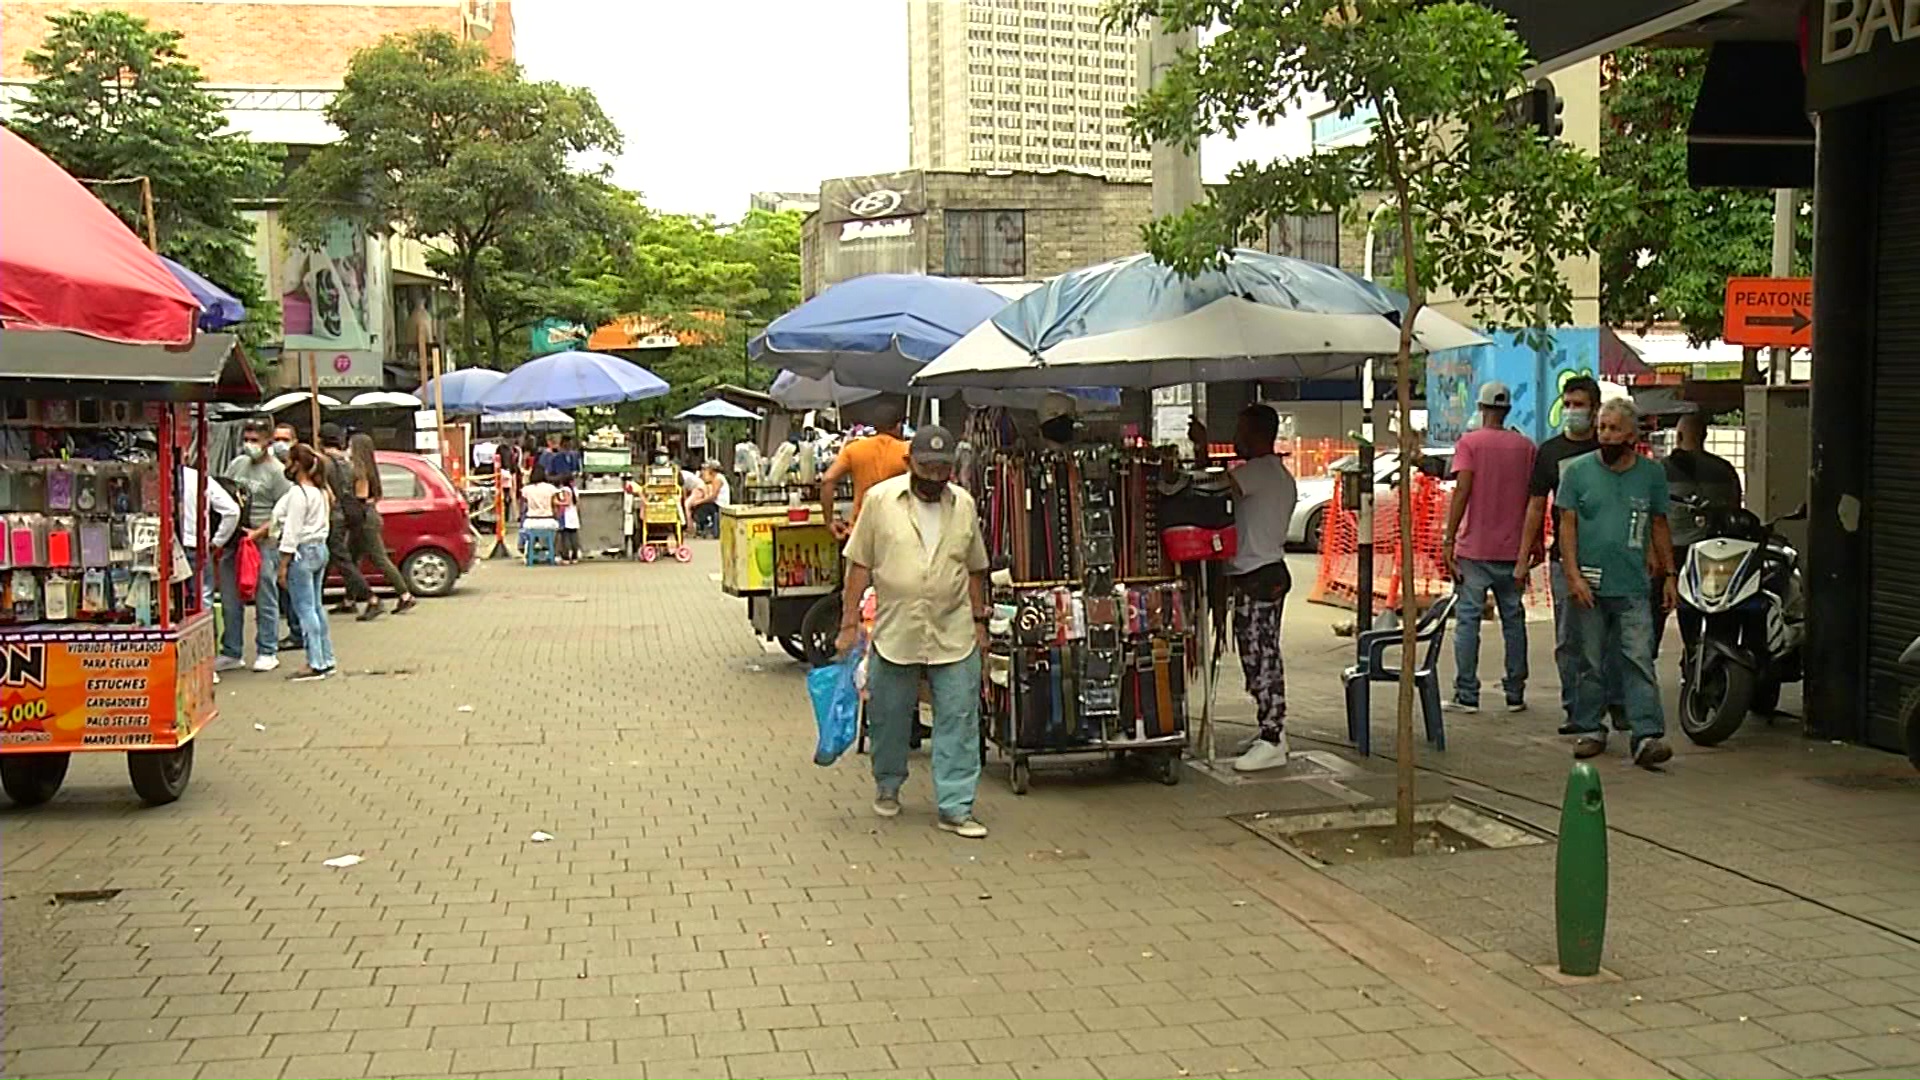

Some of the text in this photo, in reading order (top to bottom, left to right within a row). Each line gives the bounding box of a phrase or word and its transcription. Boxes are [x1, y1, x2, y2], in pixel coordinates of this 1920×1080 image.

[67, 642, 164, 653] VIDRIOS TEMPLADOS
[82, 657, 150, 669] PARA CELULAR
[86, 678, 147, 690] ESTUCHES
[86, 697, 149, 708] CARGADORES
[86, 715, 149, 727] PALO SELFIES
[83, 733, 153, 745] MANOS LIBRES
